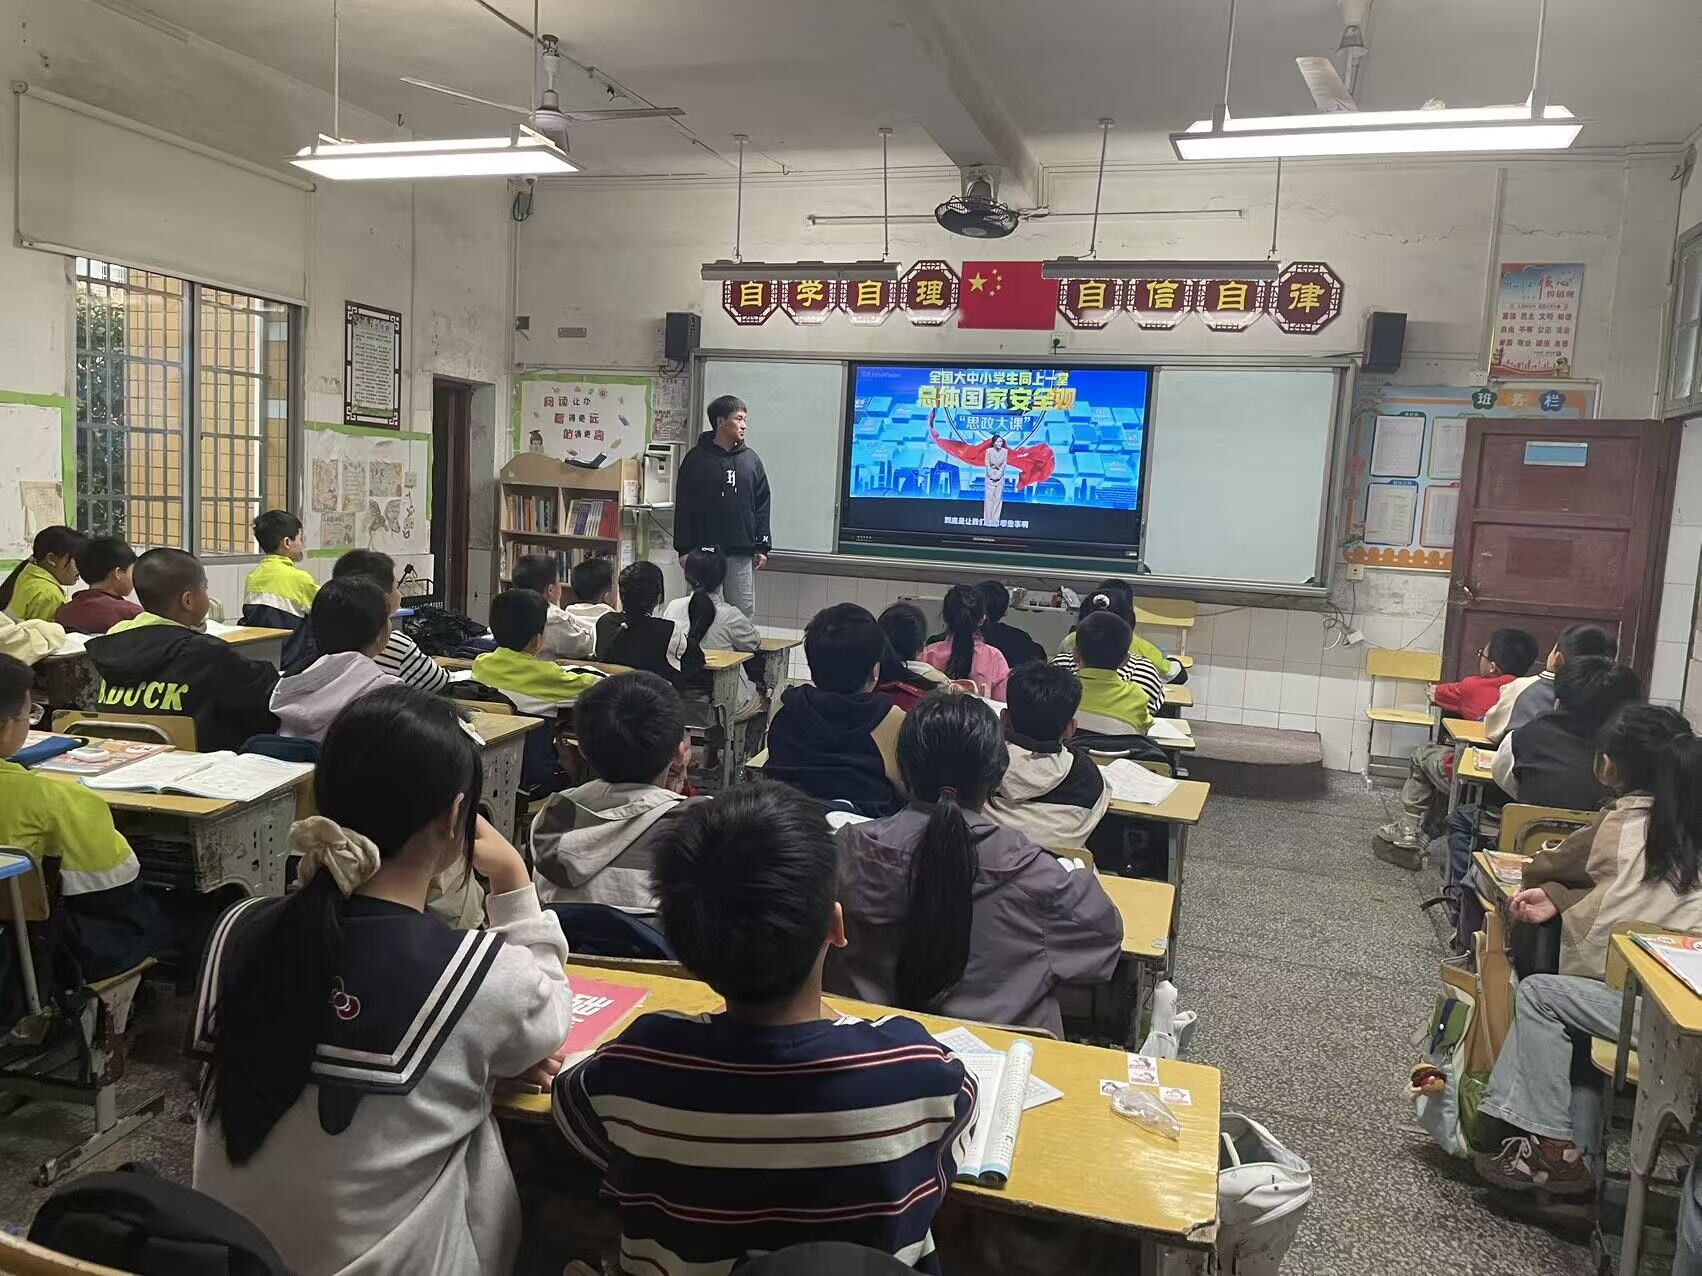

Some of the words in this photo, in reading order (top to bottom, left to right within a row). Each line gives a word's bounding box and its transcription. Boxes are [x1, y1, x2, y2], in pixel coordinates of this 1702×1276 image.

[739, 280, 945, 307] 自学自理
[1077, 280, 1326, 314] 自信自律
[929, 371, 1069, 386] 全国大中小学生同上一堂
[918, 385, 1076, 411] 总体国家安全观
